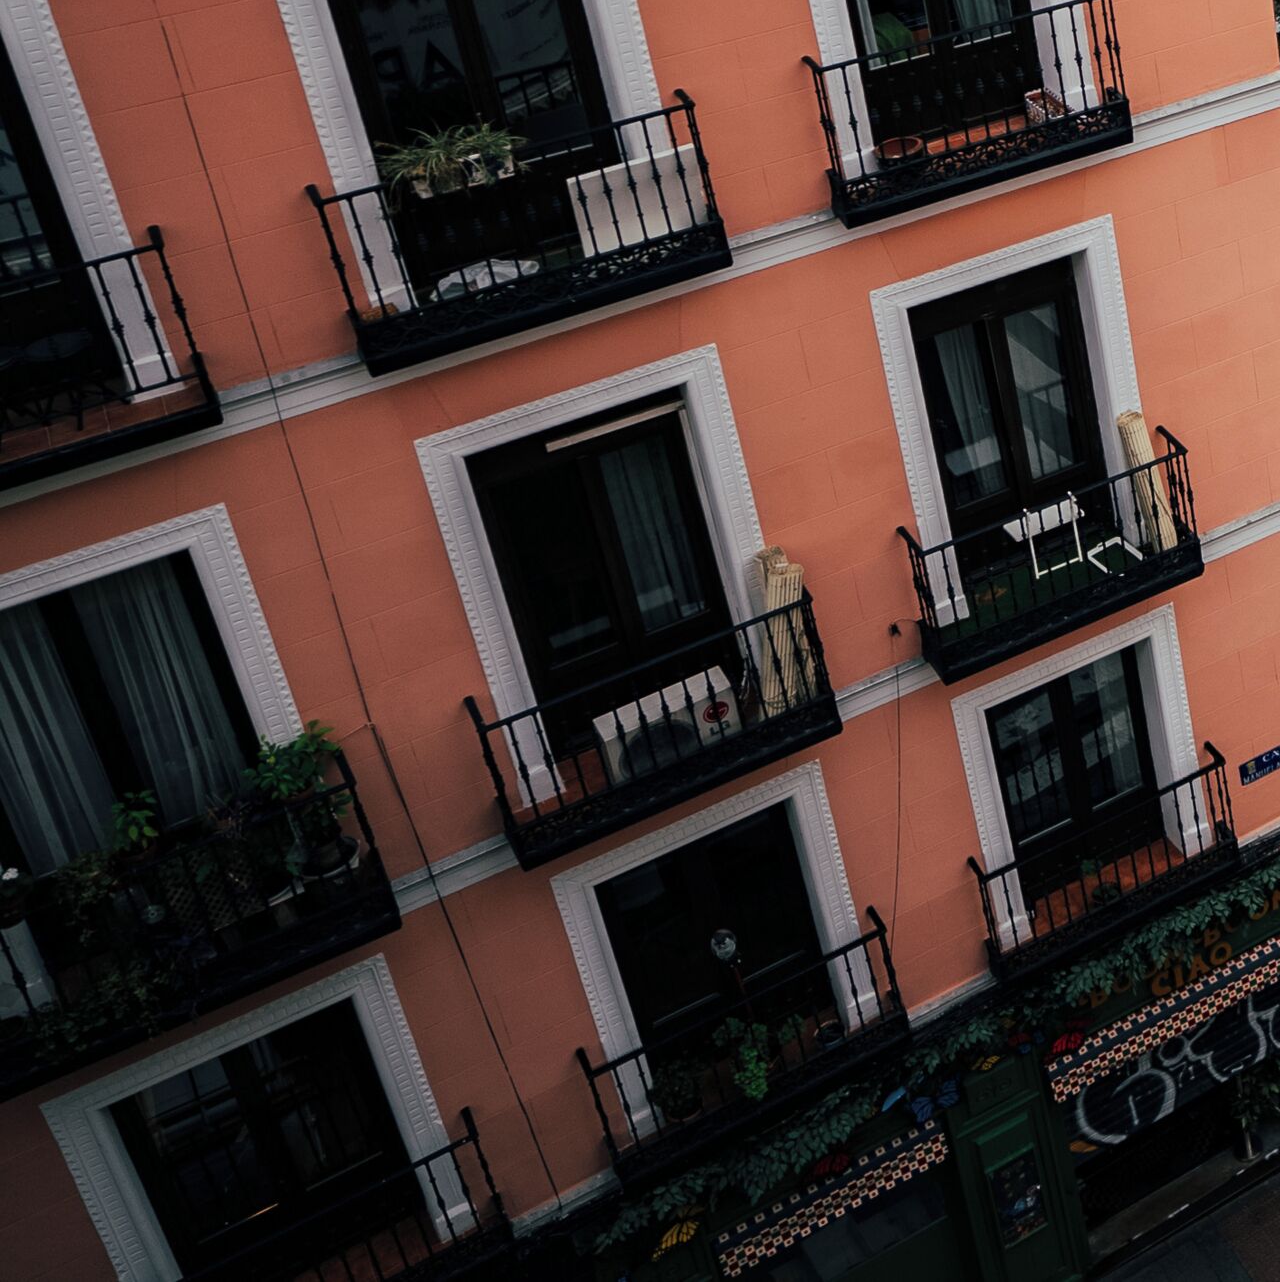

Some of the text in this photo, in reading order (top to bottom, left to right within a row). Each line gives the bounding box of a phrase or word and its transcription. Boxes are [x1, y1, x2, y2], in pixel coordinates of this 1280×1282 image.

[710, 720, 730, 735] LG
[1243, 760, 1280, 785] MANUELA
[1151, 941, 1232, 997] CIAO
